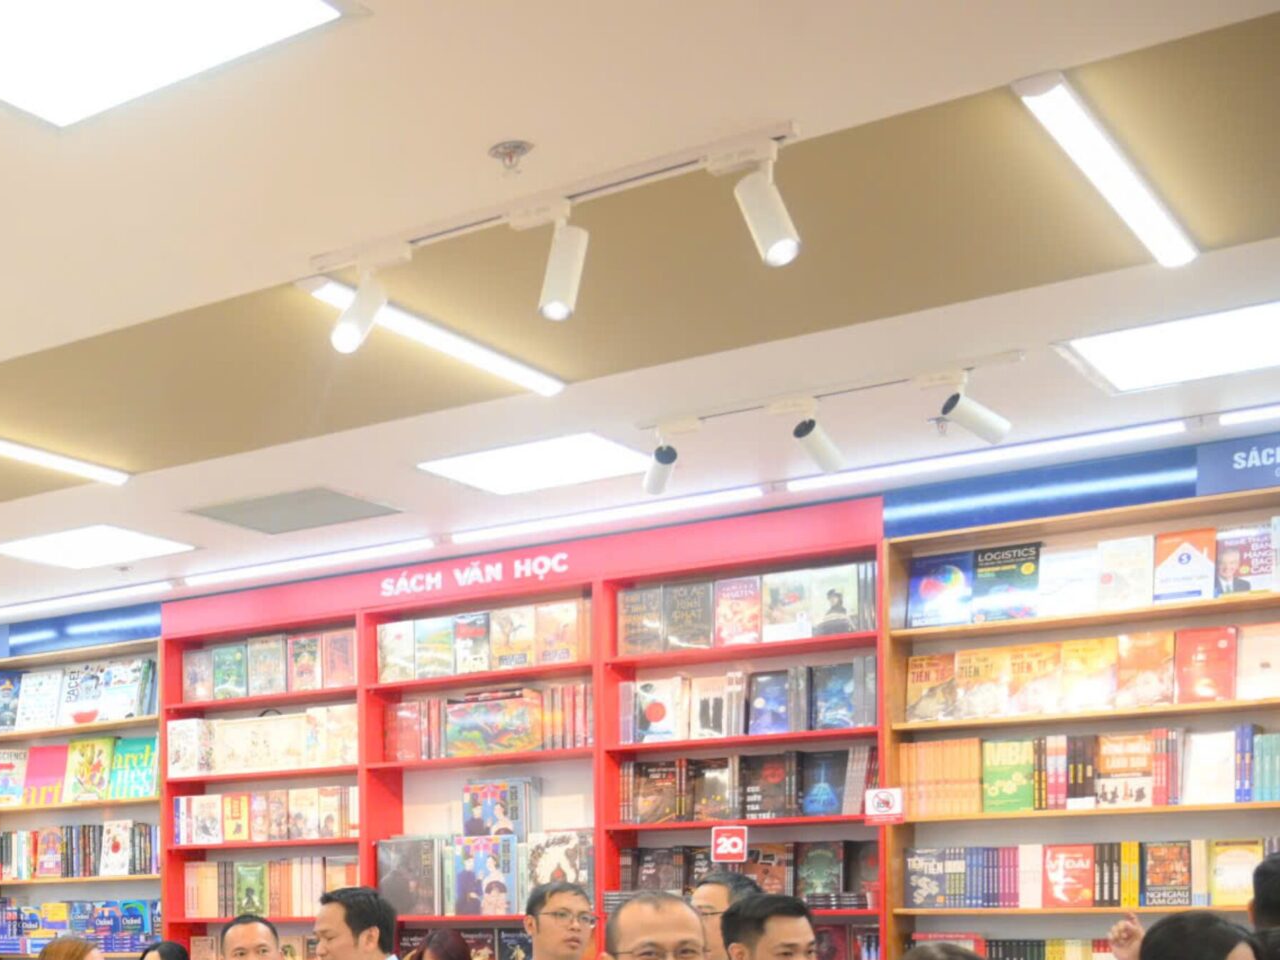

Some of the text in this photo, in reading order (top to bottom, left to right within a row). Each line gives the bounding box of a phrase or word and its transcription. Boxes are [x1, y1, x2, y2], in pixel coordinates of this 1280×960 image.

[1233, 446, 1280, 469] SÁC
[977, 547, 1036, 562] LOGISTICS
[380, 552, 569, 597] SÁCH VĂN HỌC
